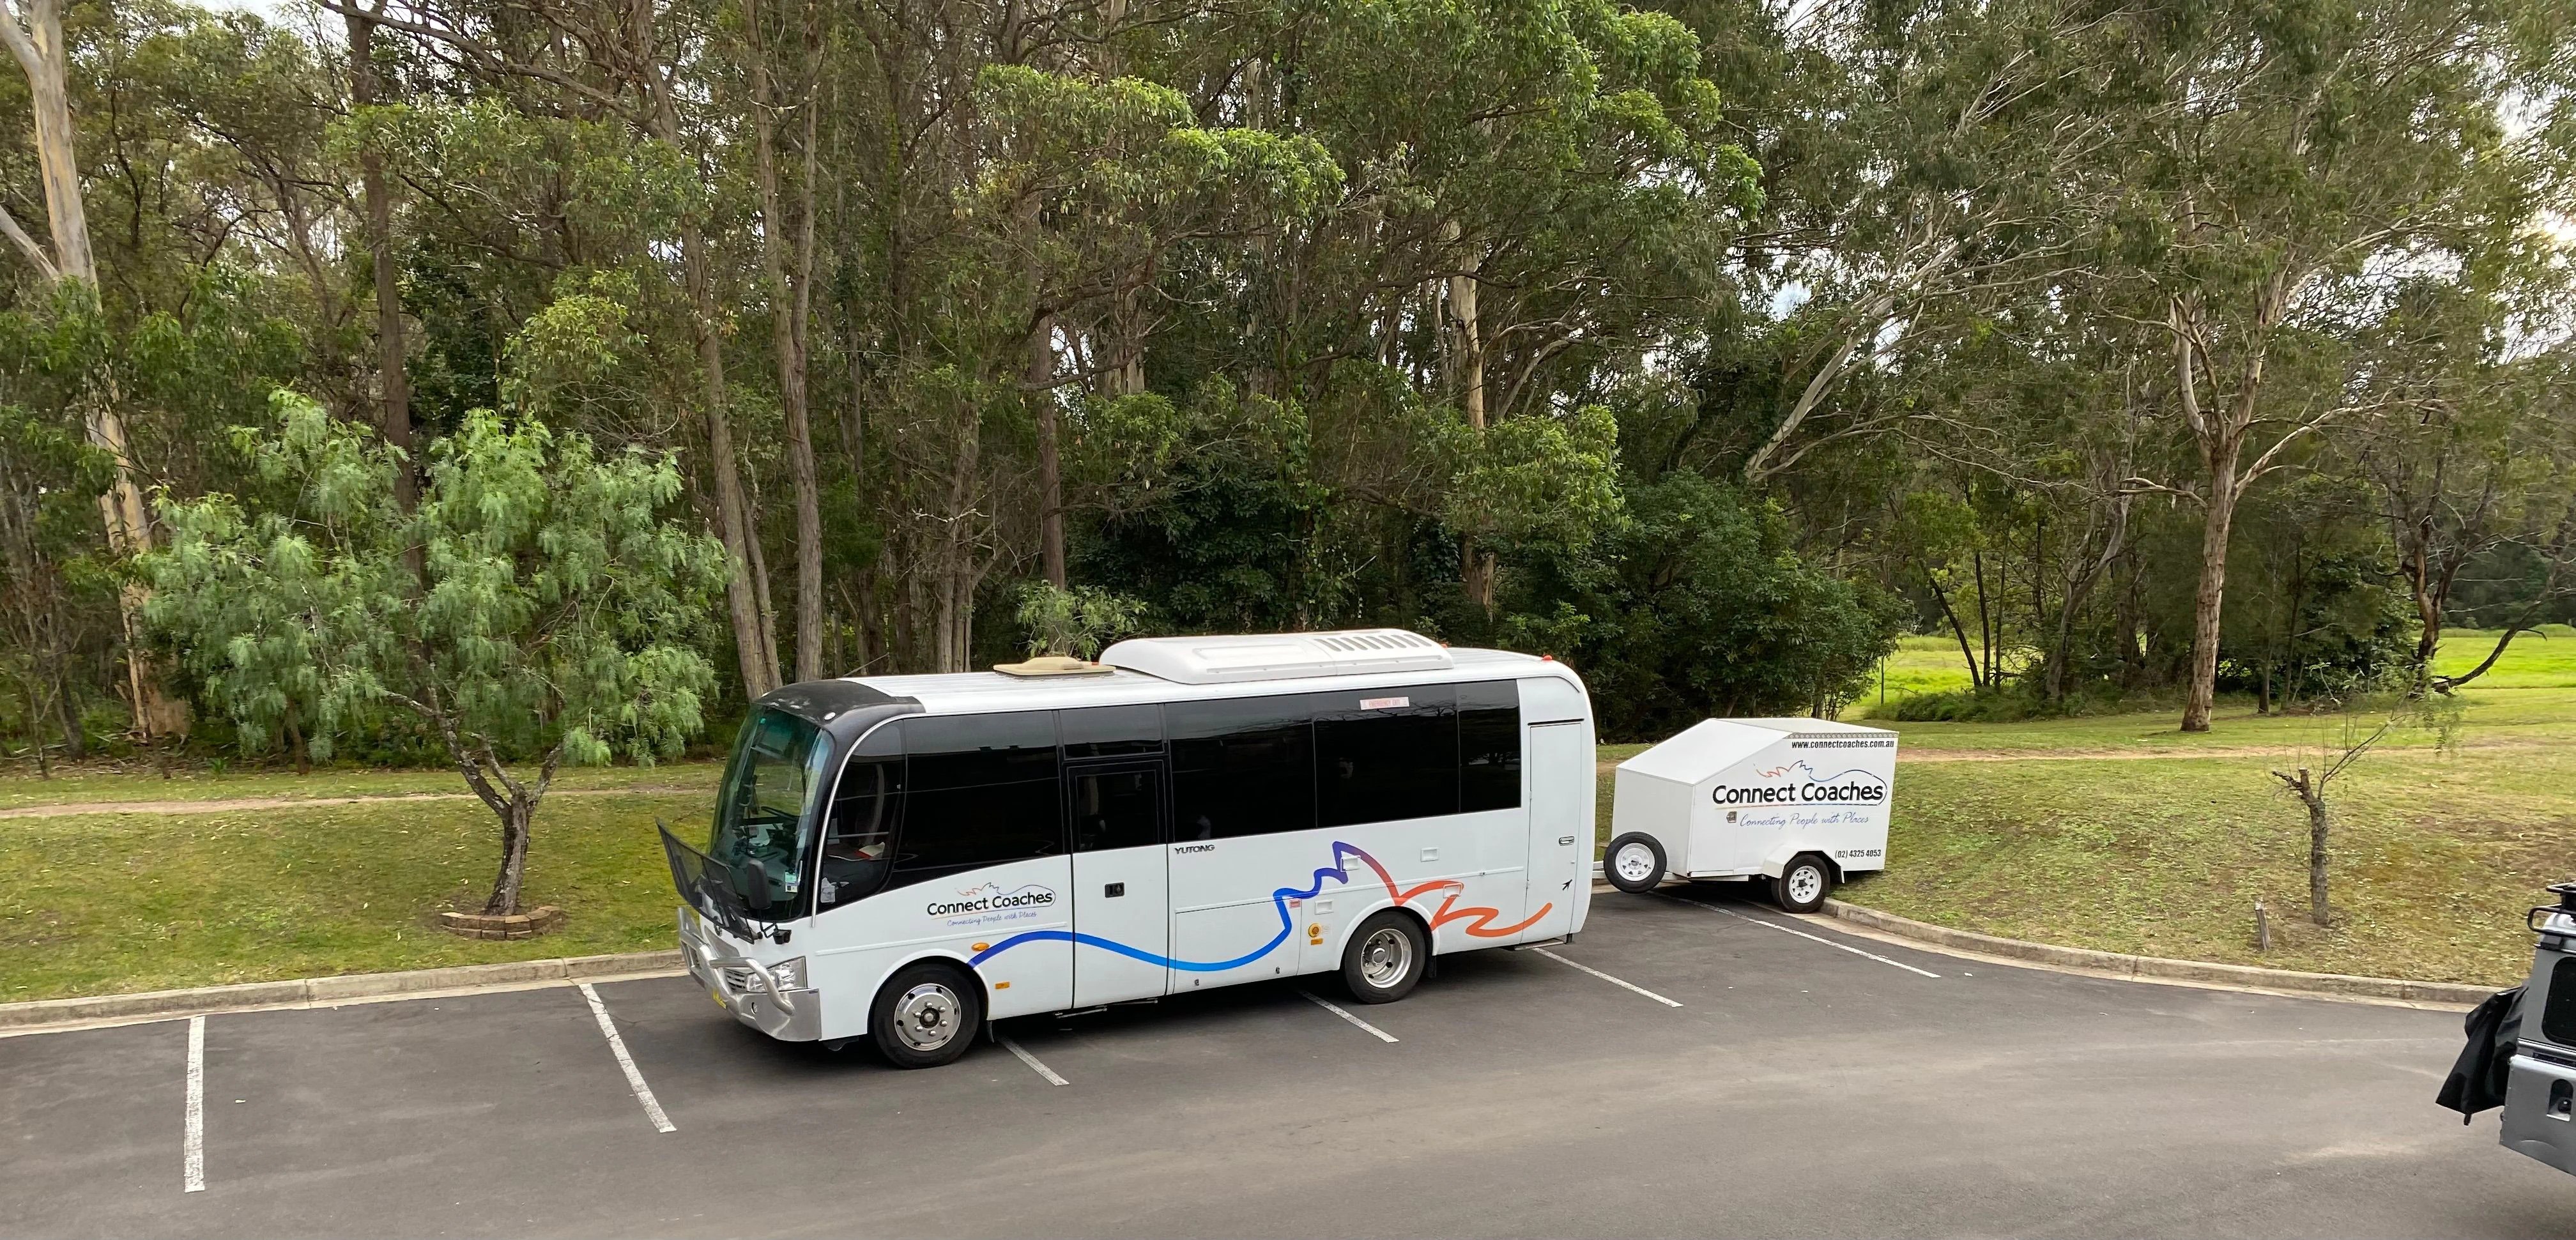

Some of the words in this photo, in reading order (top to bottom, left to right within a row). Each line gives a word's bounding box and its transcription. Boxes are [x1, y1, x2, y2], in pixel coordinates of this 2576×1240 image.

[1791, 740, 1894, 749] www.connectcoaches.com.au
[1712, 783, 1796, 805] Connect
[1801, 781, 1883, 802] Coaches
[1740, 813, 1786, 830] Connecting
[1790, 813, 1818, 829] People
[1821, 812, 1840, 824] with
[1843, 811, 1869, 824] Places
[1174, 844, 1215, 855] YUTONG
[1835, 850, 1848, 859] (02)
[927, 898, 989, 916] Connect
[992, 892, 1054, 908] Coaches
[947, 917, 981, 926] Connecting
[982, 914, 1002, 923] People
